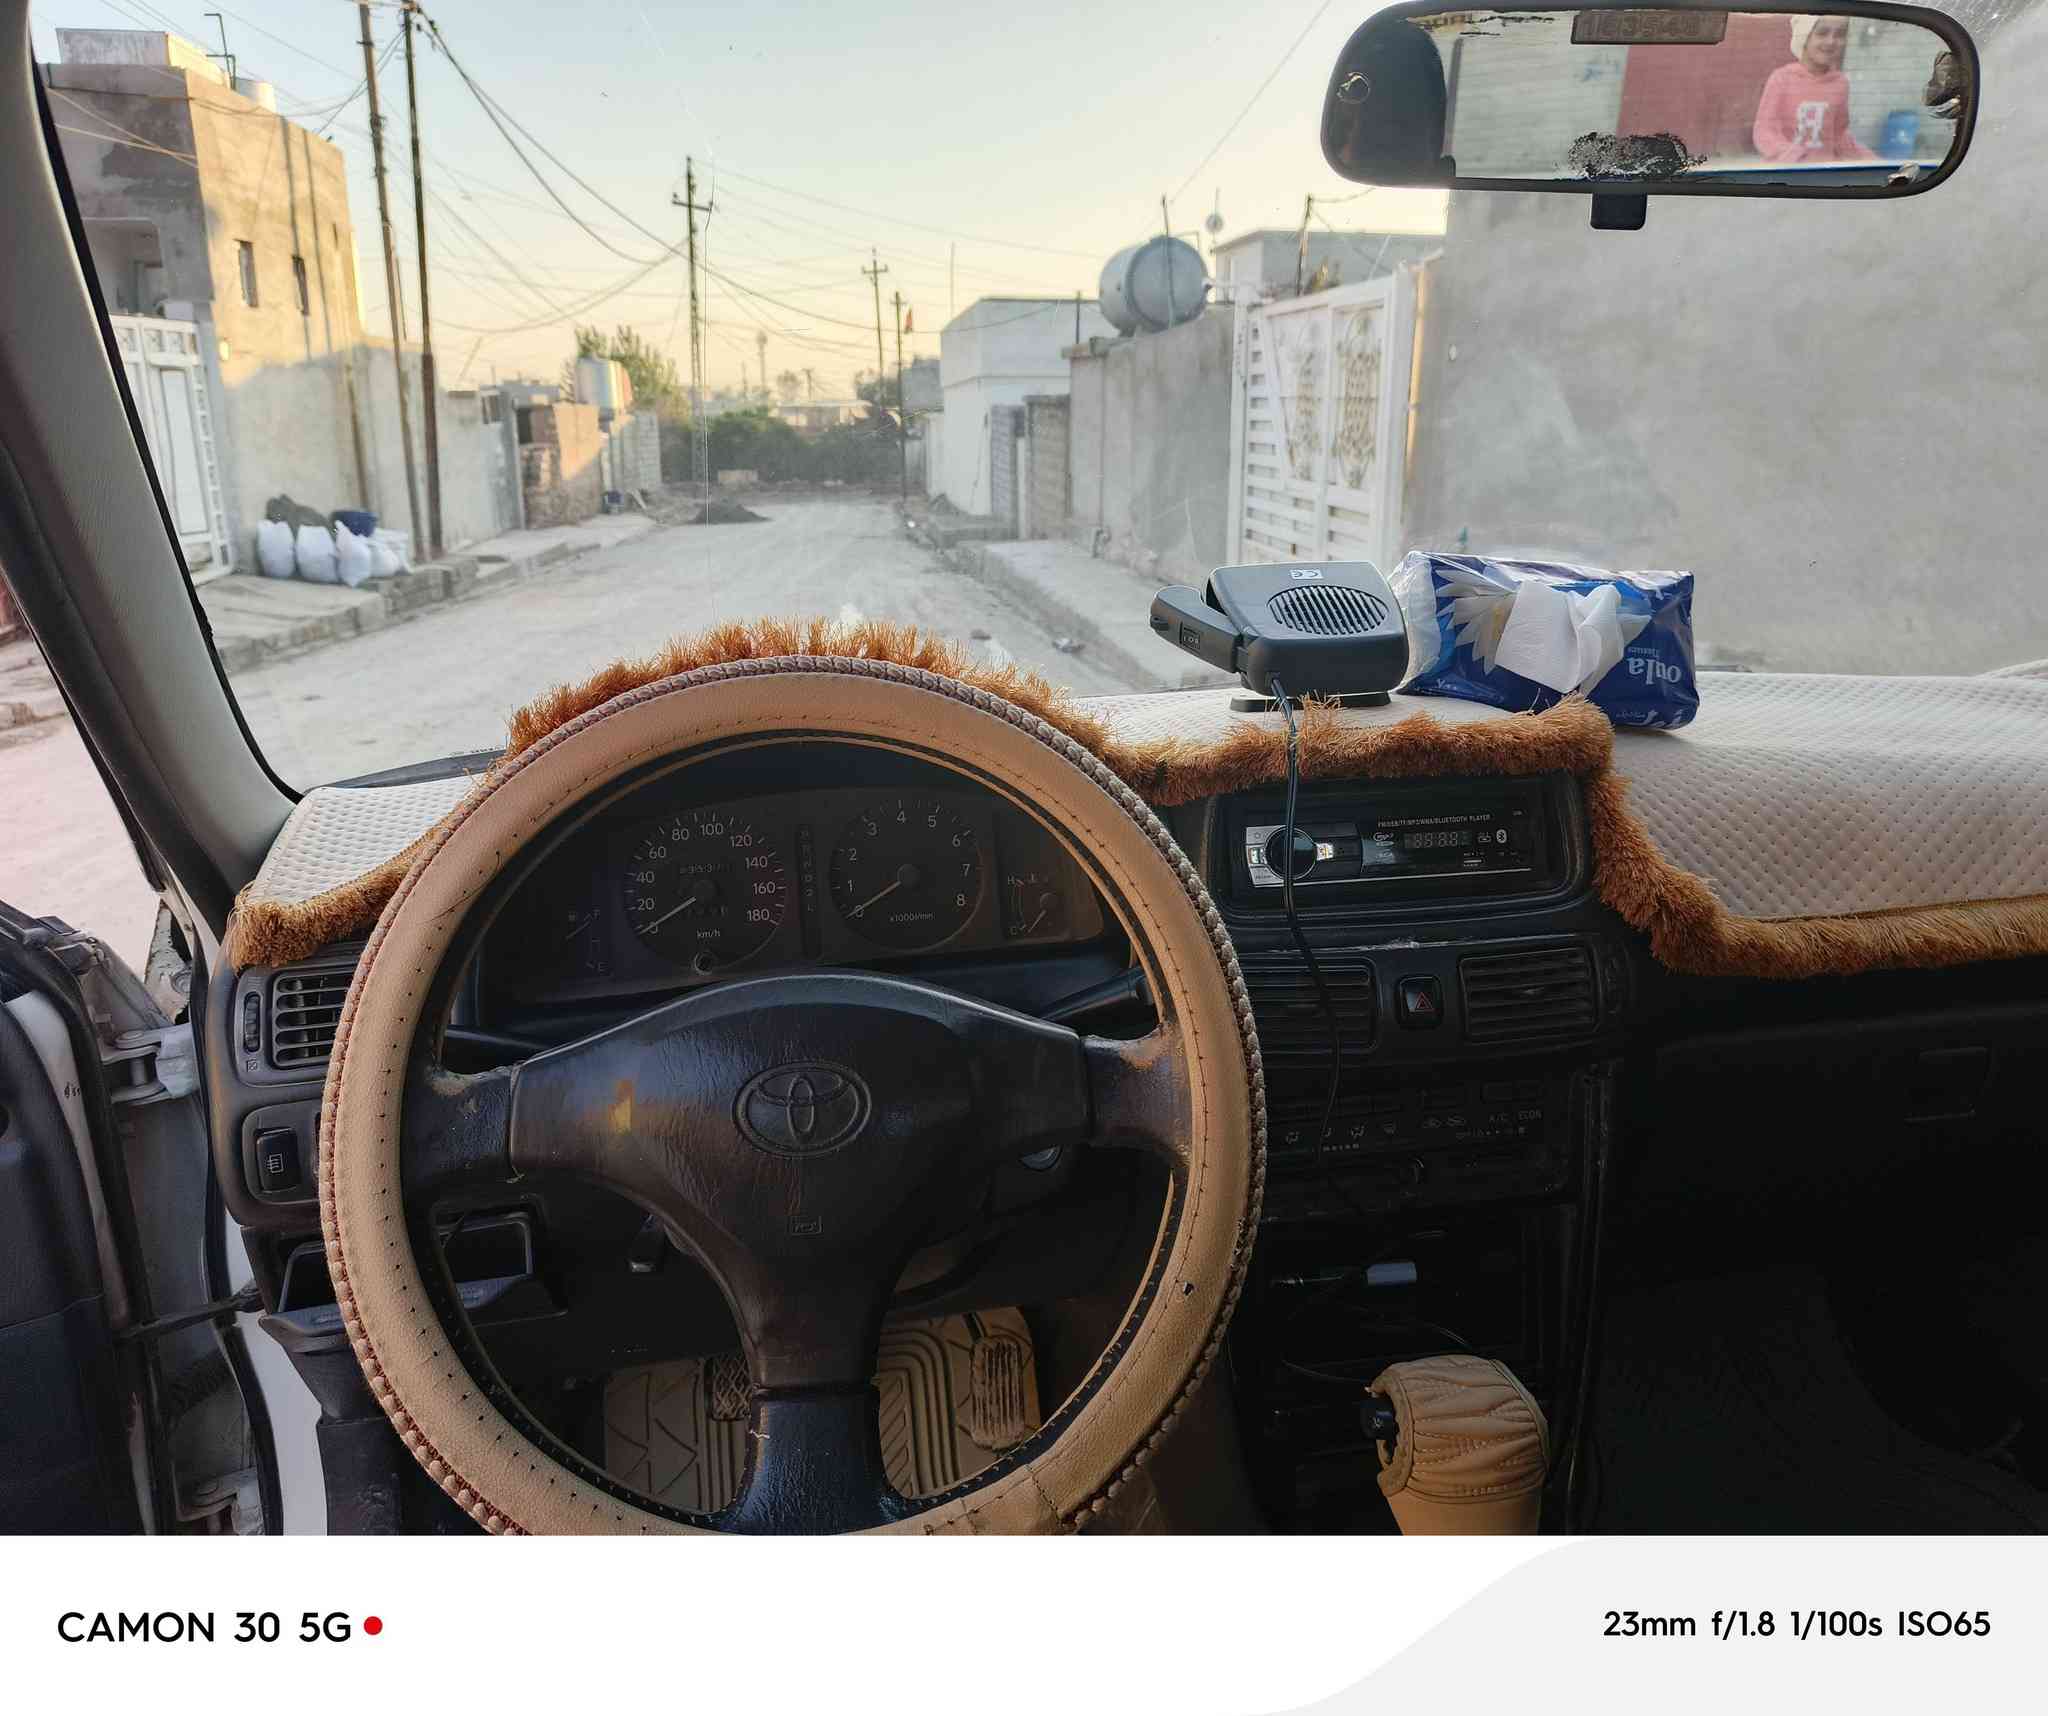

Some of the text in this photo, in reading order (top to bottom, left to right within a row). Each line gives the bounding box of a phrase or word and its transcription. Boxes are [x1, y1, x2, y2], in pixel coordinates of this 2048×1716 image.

[1625, 656, 1682, 686] oula
[896, 811, 906, 824] 4
[927, 814, 937, 829] 5
[671, 828, 689, 841] 80
[700, 822, 724, 836] 100
[866, 822, 877, 837] 3
[731, 834, 753, 848] 120
[952, 833, 961, 848] 6
[647, 846, 666, 859] 60
[848, 848, 857, 862] 2
[745, 855, 768, 869] 140
[637, 871, 655, 884] 40
[961, 863, 970, 878] 7
[752, 881, 776, 895] 160
[638, 899, 655, 911] 20
[956, 893, 965, 907] 8
[747, 908, 771, 922] 180
[696, 928, 721, 938] km/h
